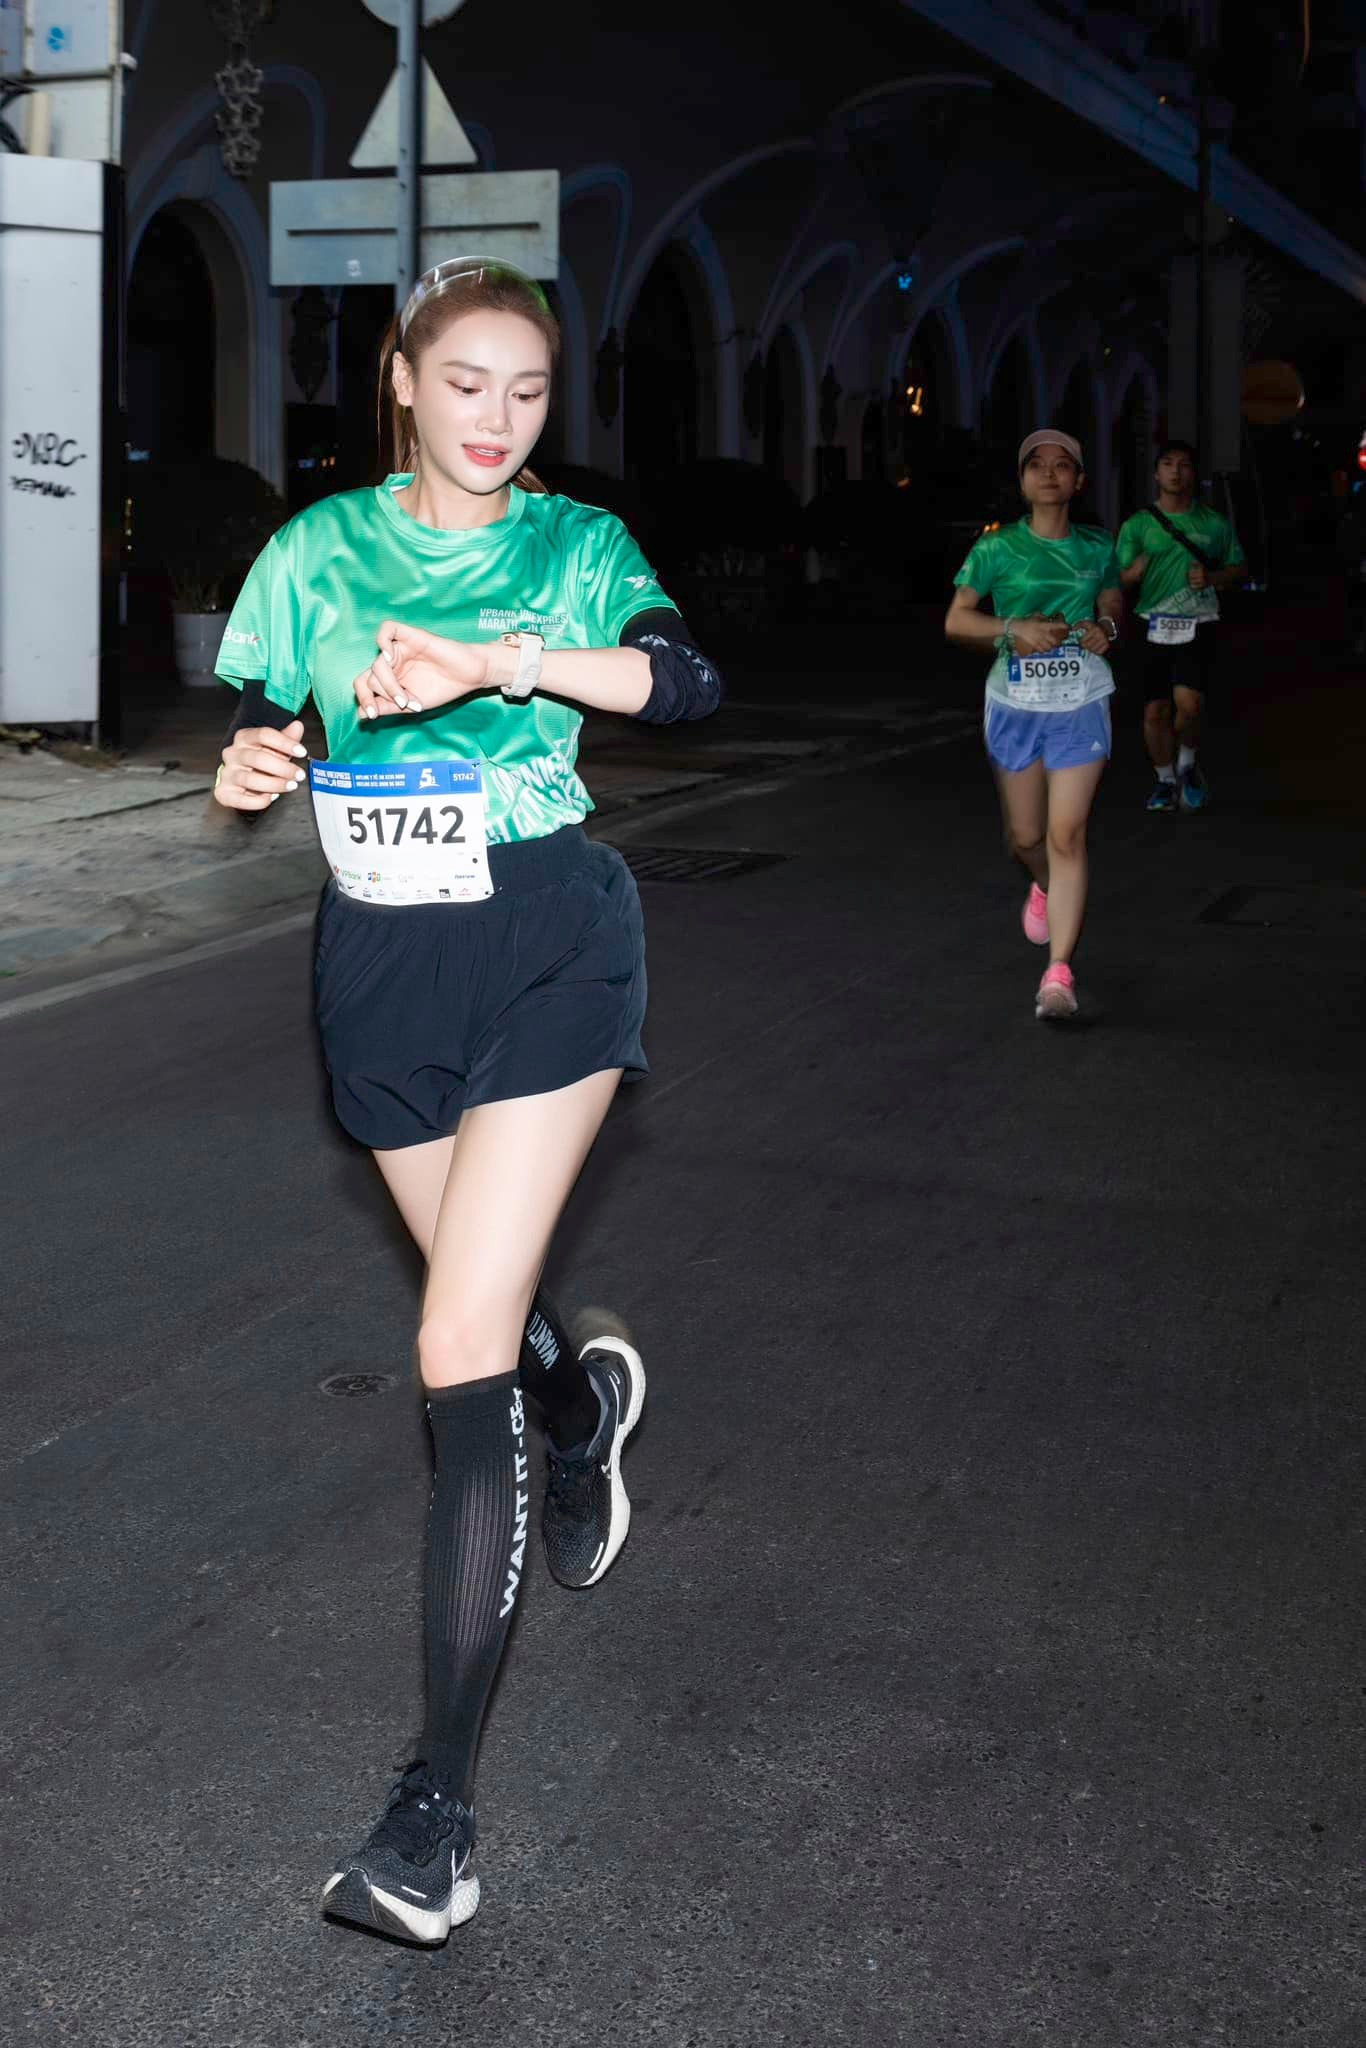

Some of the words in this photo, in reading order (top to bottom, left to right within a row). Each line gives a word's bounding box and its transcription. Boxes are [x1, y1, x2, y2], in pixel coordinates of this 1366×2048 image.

[479, 608, 517, 617] VPBANK
[1025, 660, 1080, 678] 50699
[453, 773, 475, 782] 51742
[347, 805, 466, 846] 51742
[528, 1319, 560, 1370] WANT
[499, 1490, 529, 1618] WANT
[514, 1453, 528, 1483] IT
